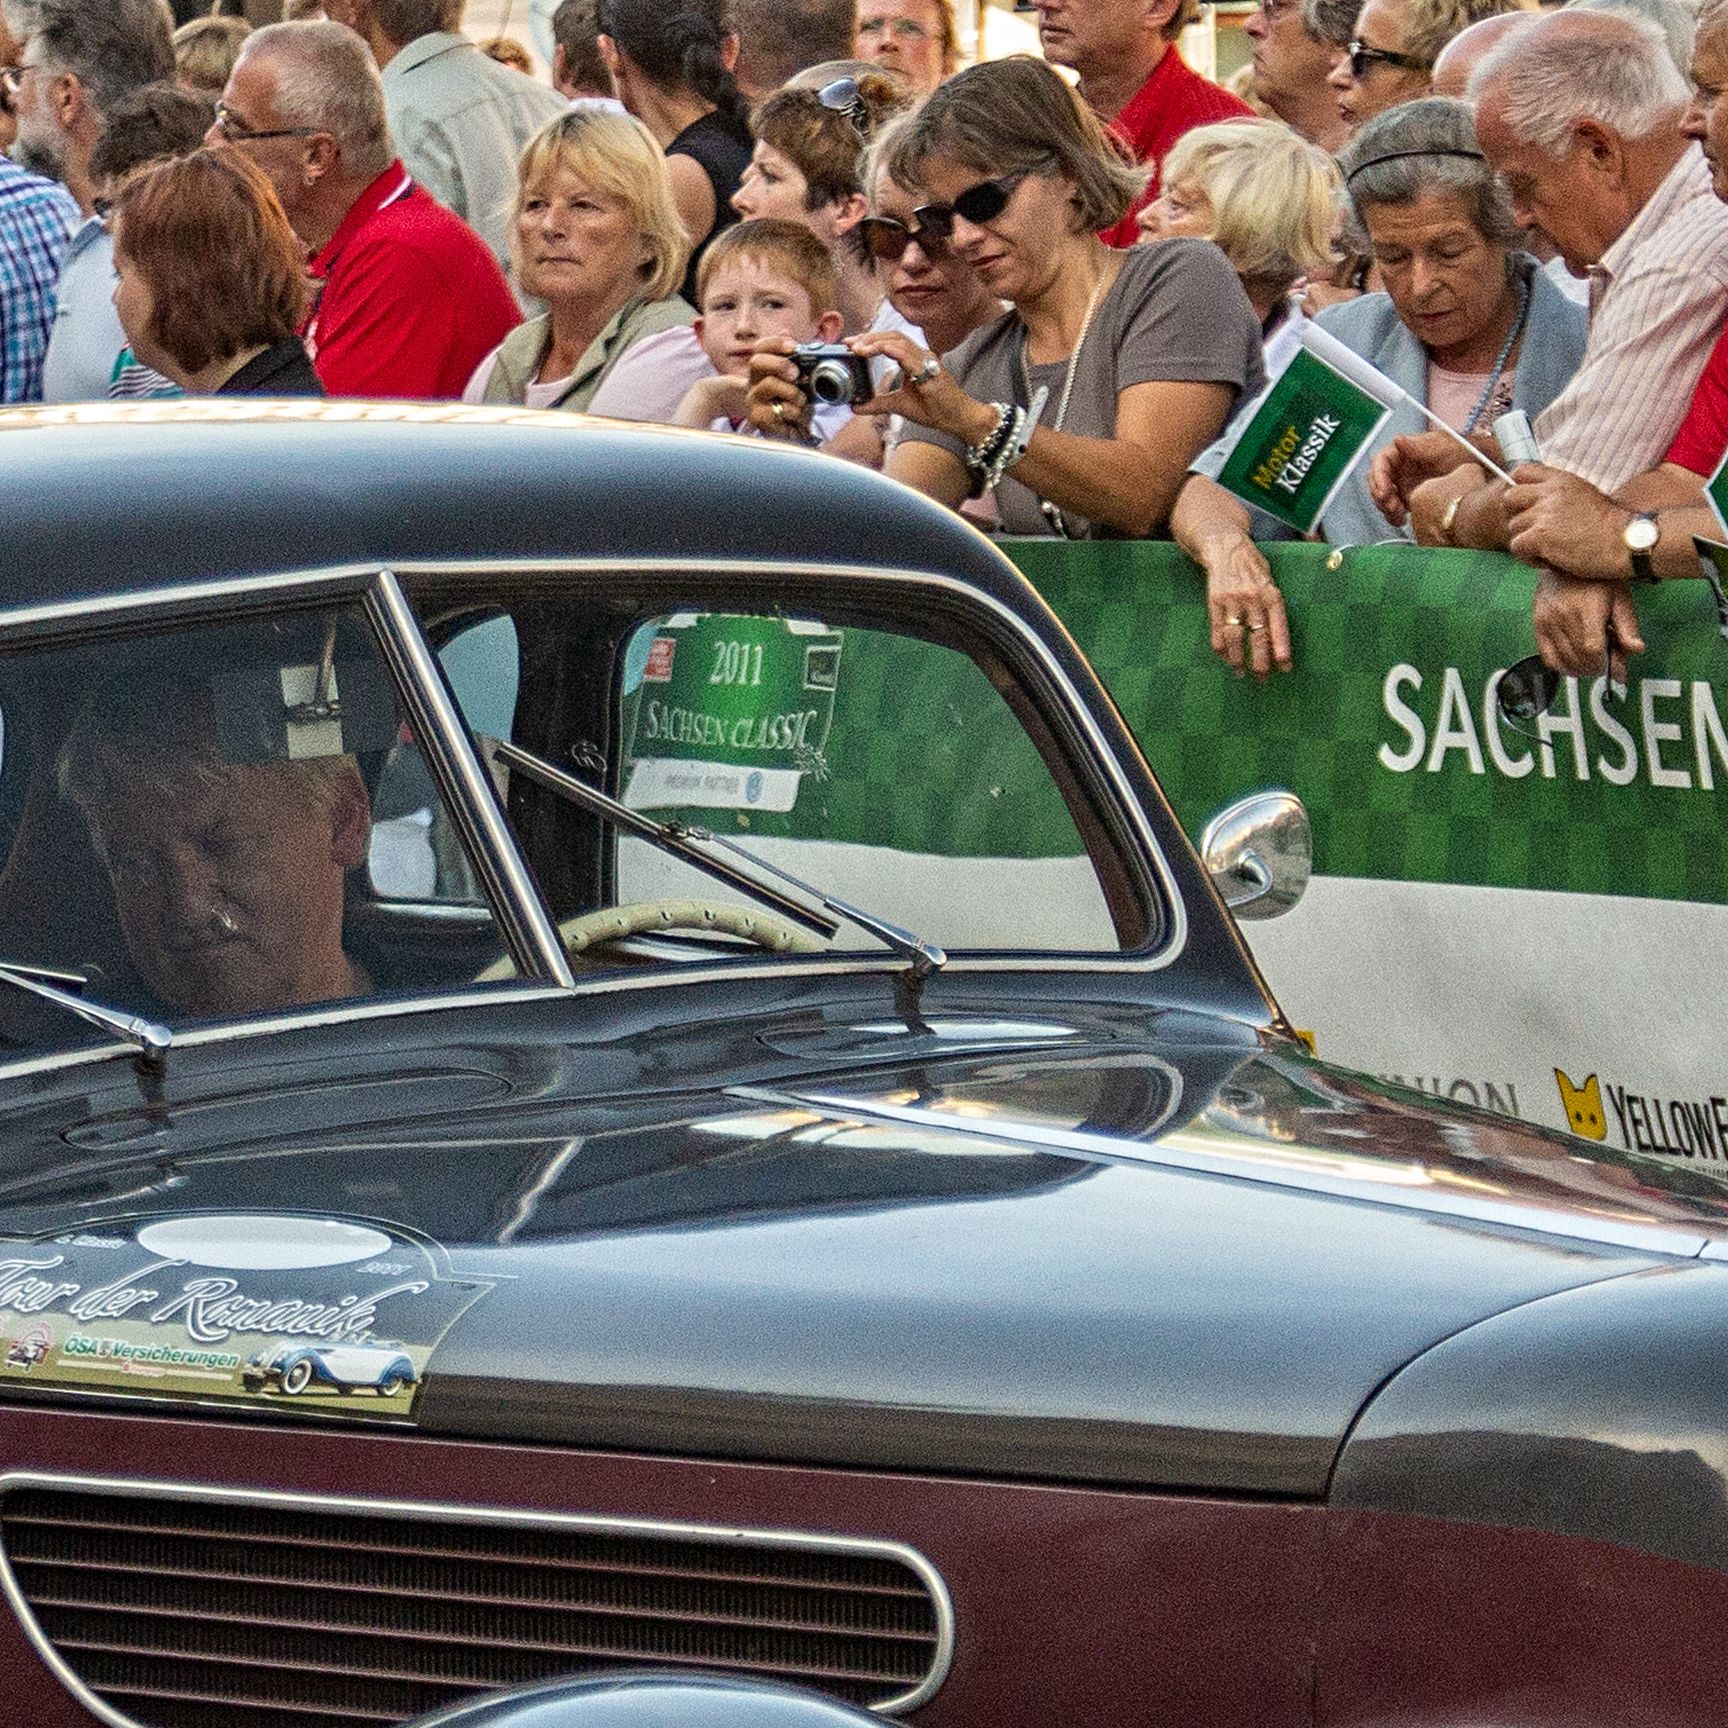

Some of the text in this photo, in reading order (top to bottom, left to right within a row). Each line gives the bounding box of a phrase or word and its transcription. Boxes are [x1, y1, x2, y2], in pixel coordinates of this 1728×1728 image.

[1250, 425, 1302, 490] Motor
[1275, 412, 1341, 494] Klassik
[708, 640, 764, 686] 2011
[647, 700, 818, 750] SACHSEN CLASSIC
[68, 1258, 189, 1322] der
[153, 1278, 430, 1342] Romanik
[110, 1341, 238, 1370] Versicherungen
